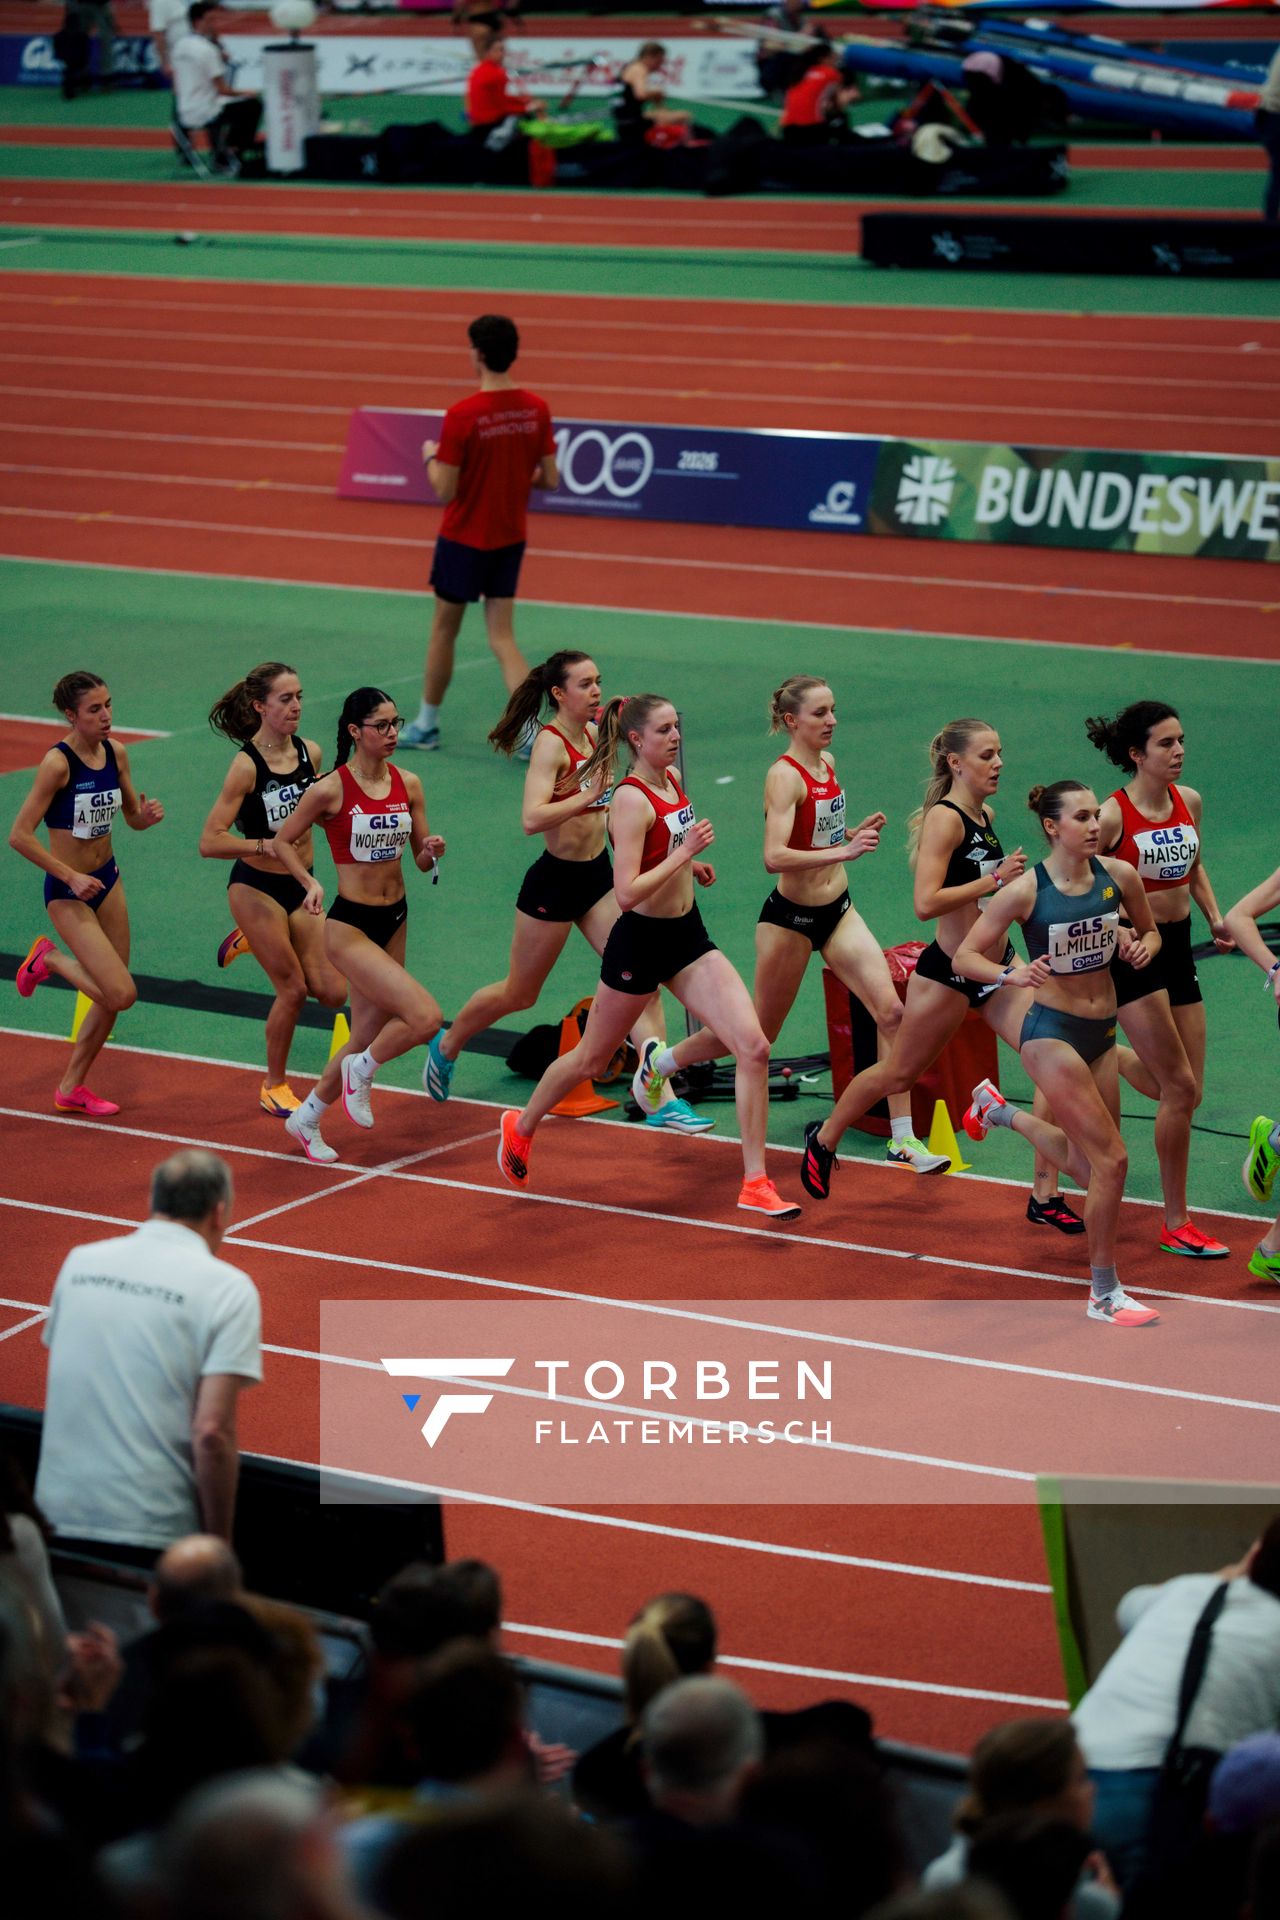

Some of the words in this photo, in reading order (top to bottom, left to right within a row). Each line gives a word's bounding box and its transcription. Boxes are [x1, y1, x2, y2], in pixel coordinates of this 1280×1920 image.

[22, 37, 66, 71] GL
[553, 428, 654, 497] 100
[974, 466, 1280, 541] BUNDESWE
[91, 792, 114, 807] GLS
[279, 786, 302, 802] GL
[270, 801, 299, 821] LOR
[678, 805, 693, 825] GLS
[370, 815, 398, 829] GLS
[355, 832, 386, 848] WOLFF
[1152, 828, 1183, 845] GLS
[1144, 843, 1196, 864] HAISCH
[1068, 918, 1103, 938] GLS
